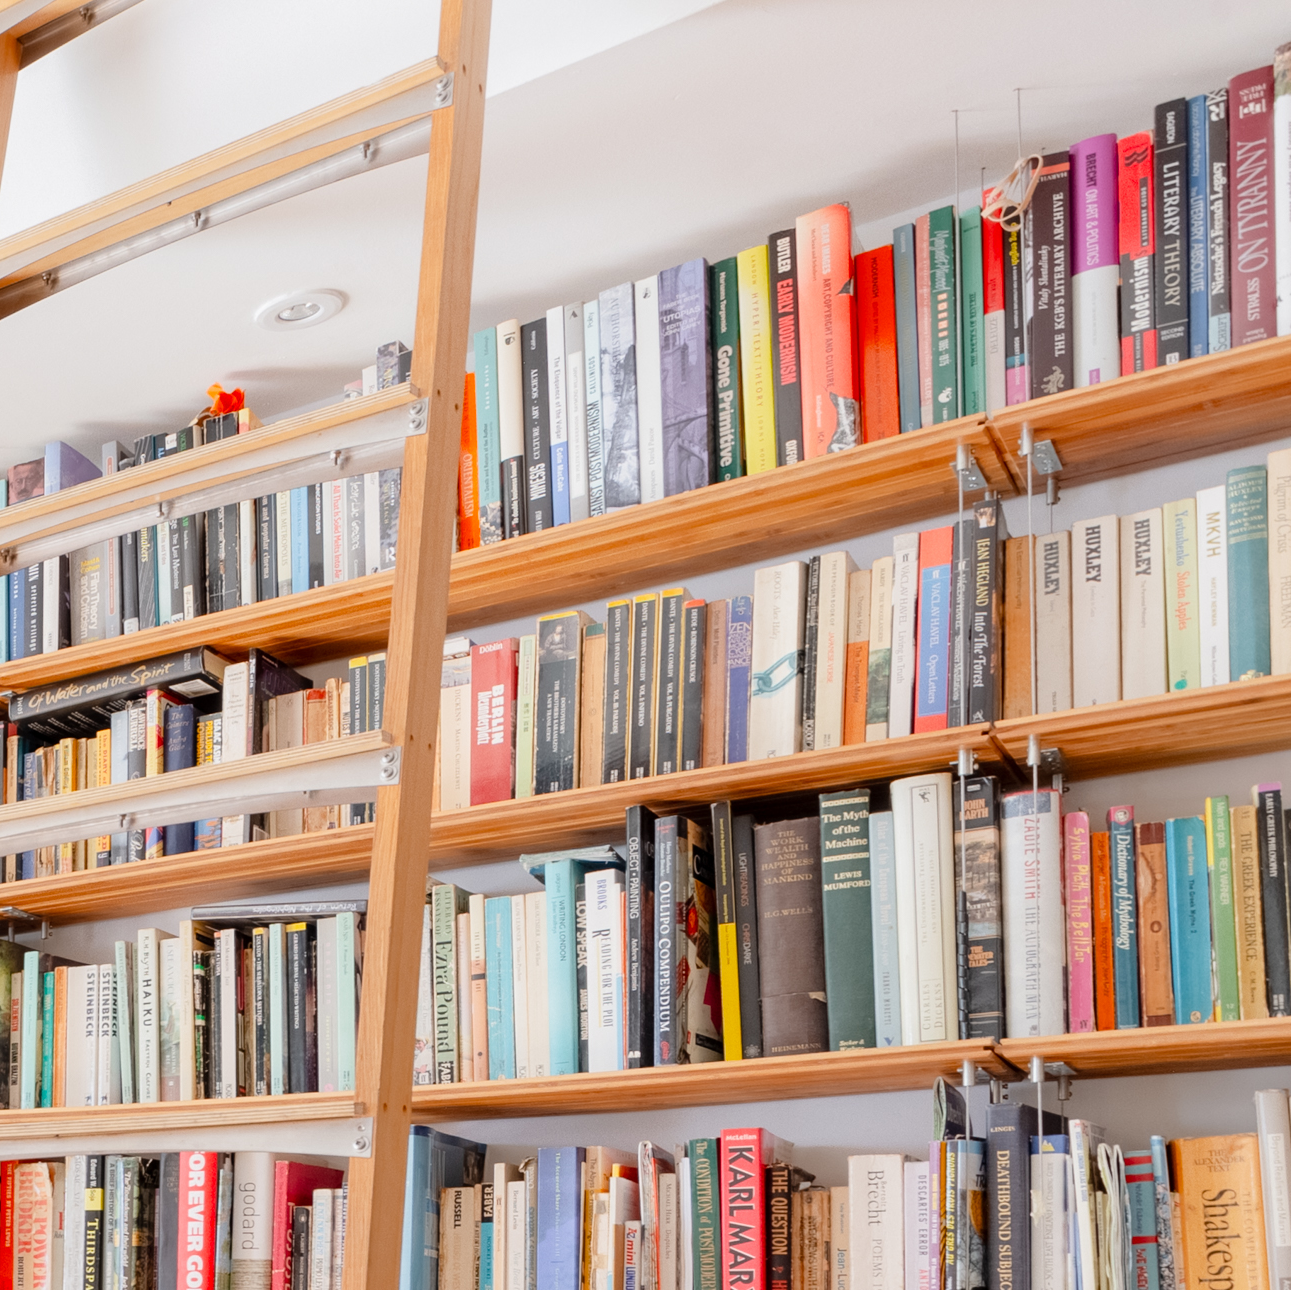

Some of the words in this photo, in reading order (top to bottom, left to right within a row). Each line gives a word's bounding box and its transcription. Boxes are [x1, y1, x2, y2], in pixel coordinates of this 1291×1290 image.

[1086, 153, 1097, 187] BRECHT
[1210, 161, 1226, 192] Legacy
[1237, 137, 1267, 230] TYRANNY
[1053, 192, 1063, 235] ARCHIVE
[1086, 189, 1098, 203] ON
[1086, 204, 1098, 219] ART
[1163, 161, 1180, 237] LITERARY
[1210, 194, 1223, 240] French
[776, 236, 791, 273] BUTLER
[1053, 238, 1064, 293] LITERARY
[1087, 229, 1098, 265] POLITICS
[1237, 233, 1268, 273] ON
[1164, 243, 1181, 307] THEORY
[1210, 243, 1225, 296] Nietzsche's
[776, 278, 793, 313] EARLY
[1131, 255, 1151, 333] Modernism
[1247, 277, 1260, 321] STRAUSS
[777, 315, 796, 386] MODERNISM
[1054, 333, 1064, 357] THE
[716, 344, 733, 388] Gone
[587, 400, 602, 475] POSTMODERNISM
[719, 390, 734, 467] Primitive
[462, 453, 473, 518] ORIENTALISM
[530, 462, 546, 501] MIMESIS
[334, 534, 342, 550] Melts
[976, 537, 990, 555] JEAN
[1085, 525, 1101, 583] HUXLEY
[1134, 519, 1151, 577] HUXLEY
[1205, 512, 1221, 558] MKVH
[90, 572, 100, 591] Film
[334, 568, 342, 578] Air
[976, 558, 989, 607] HEGLAND
[1044, 541, 1060, 596] HUXLEY
[1176, 571, 1185, 599] Stolen
[90, 593, 99, 630] Theory
[1176, 601, 1186, 631] Apples
[479, 642, 502, 655] Döblin
[28, 692, 42, 711] Of
[46, 684, 83, 704] Water
[86, 678, 107, 693] and
[110, 676, 127, 687] the
[130, 662, 174, 685] Spirit
[492, 684, 504, 745] BERLIN
[823, 812, 841, 823] The
[843, 810, 869, 821] Myth
[842, 824, 860, 834] the
[826, 838, 867, 849] Machine
[1118, 834, 1129, 884] Dictionary
[596, 879, 607, 911] BROOKS
[824, 880, 871, 891] MUMFORD
[834, 871, 862, 880] LEWIS
[1072, 864, 1088, 892] Plath
[1119, 886, 1127, 897] of
[659, 881, 671, 936] OULIPO
[1071, 896, 1087, 917] The
[1117, 899, 1134, 950] Mythology
[592, 928, 611, 970] READING
[1072, 920, 1088, 944] Bell
[1075, 946, 1089, 963] Jar
[602, 972, 611, 989] FOR
[602, 991, 613, 1009] THE
[659, 939, 670, 1032] COMPENDIUM
[85, 972, 95, 1038] STEINBECK
[101, 972, 110, 1038] STEINBECK
[142, 979, 152, 1028] HAIKU
[603, 1011, 613, 1028] PLOT
[729, 1145, 755, 1217] KARL
[772, 1169, 787, 1193] THE
[868, 1170, 886, 1226] Brecht
[996, 1150, 1012, 1241] DEATHBOUND
[238, 1182, 260, 1250] godard
[483, 1186, 494, 1218] FABER
[187, 1193, 204, 1252] EVER
[771, 1197, 788, 1255] QUESTION
[626, 1240, 636, 1265] mini
[837, 1249, 845, 1290] Jean-Luc
[872, 1239, 883, 1279] POEMS
